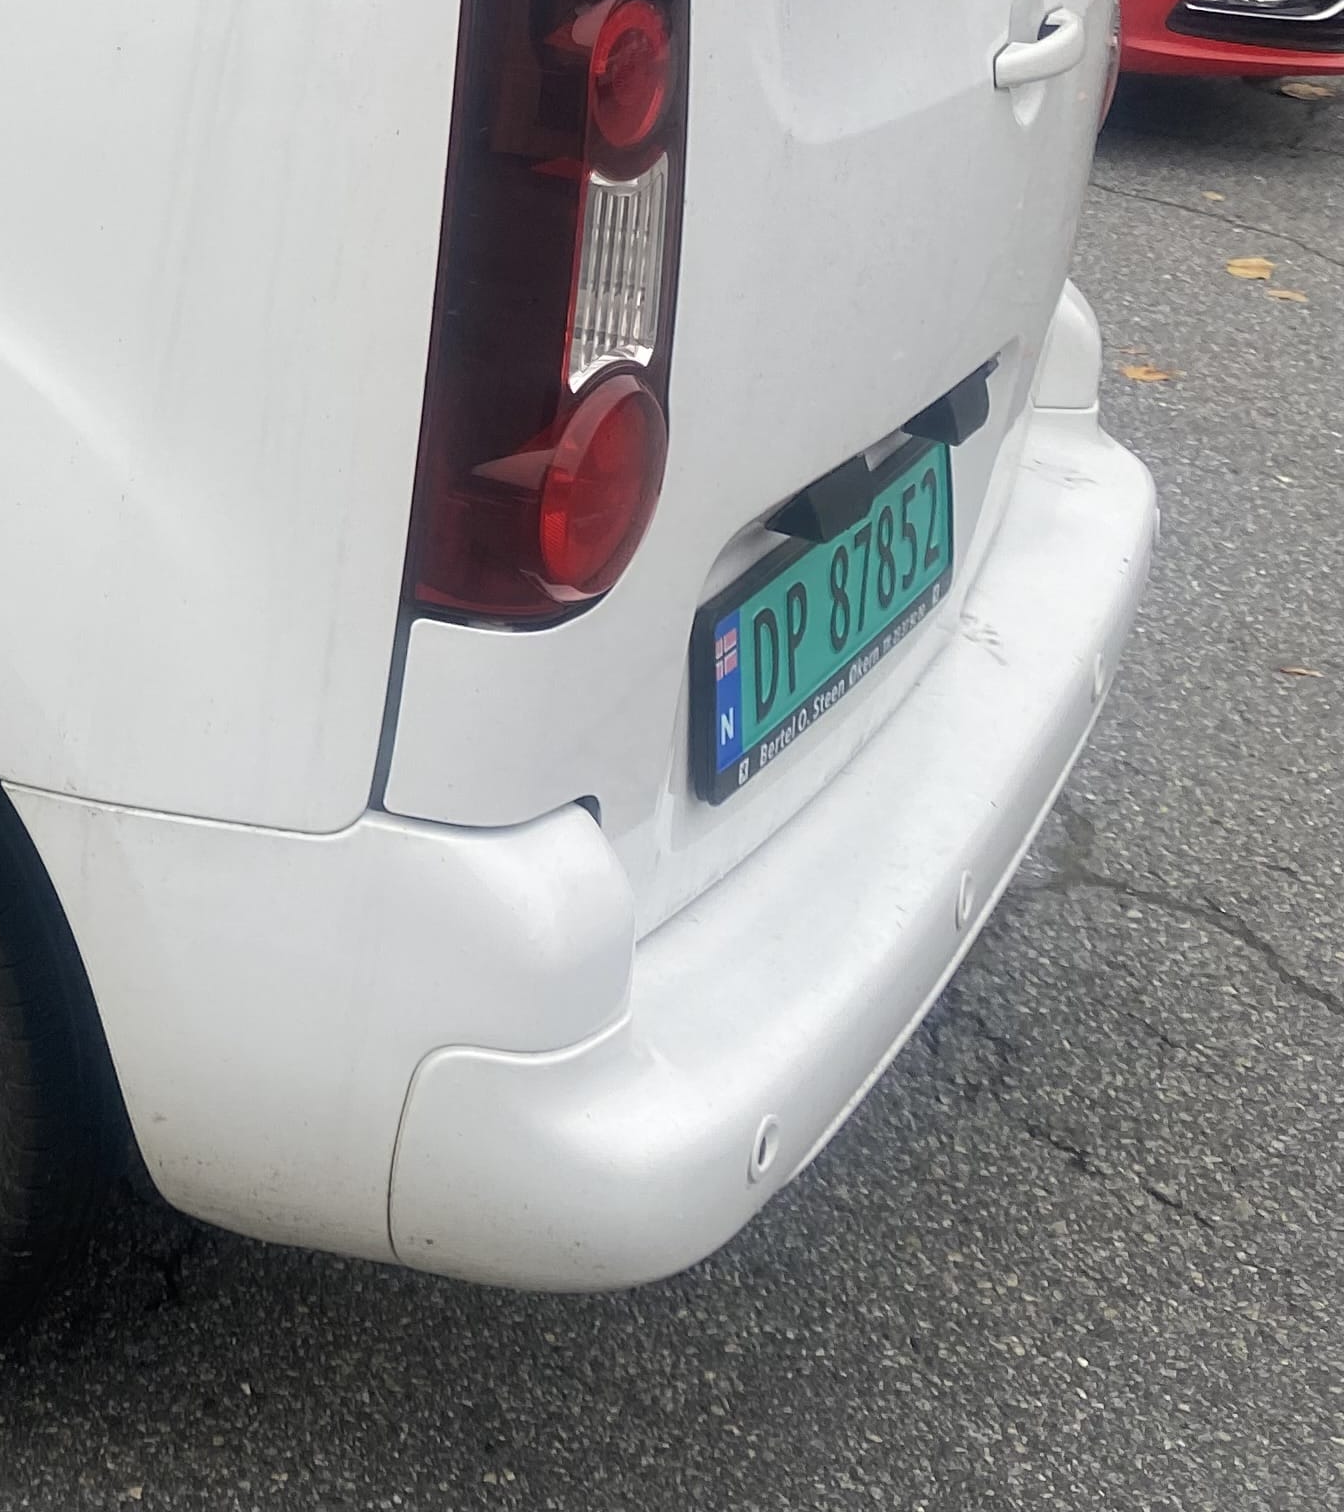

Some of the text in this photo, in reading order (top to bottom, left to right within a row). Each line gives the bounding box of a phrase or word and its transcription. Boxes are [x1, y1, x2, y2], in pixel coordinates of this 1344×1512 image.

[753, 468, 940, 724] DP 87852
[720, 707, 734, 746] N
[759, 715, 796, 767] Bertel
[812, 679, 845, 720] Steen
